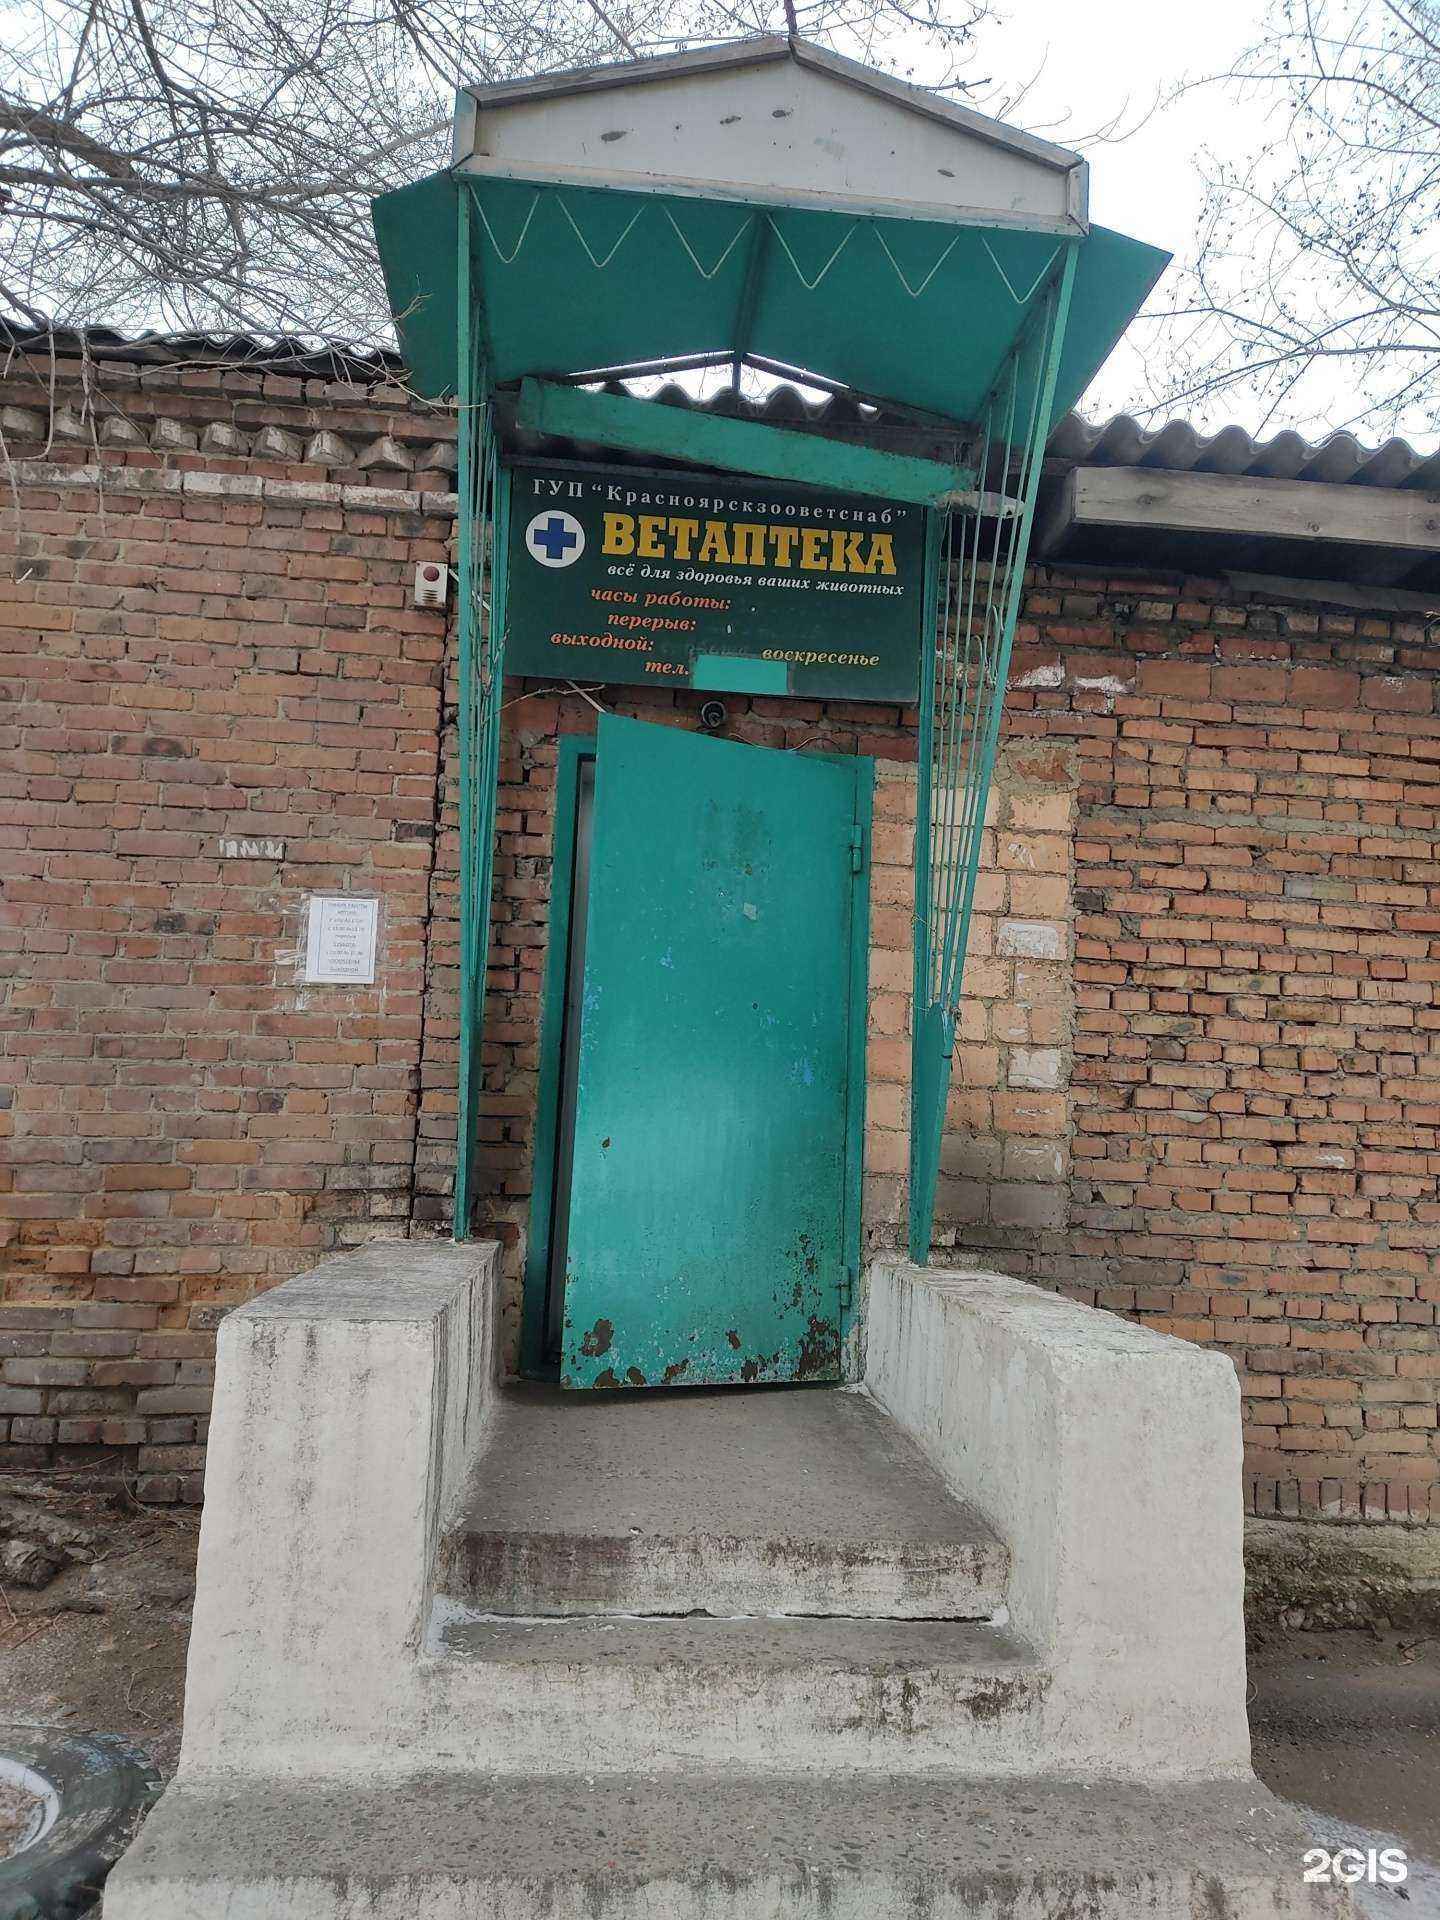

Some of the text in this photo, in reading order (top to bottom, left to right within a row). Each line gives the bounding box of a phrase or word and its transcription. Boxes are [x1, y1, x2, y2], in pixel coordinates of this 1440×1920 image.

[532, 479, 583, 498] ГУП
[601, 513, 897, 575] ВЕТАПТЕКА
[608, 563, 905, 596] всё для здоровья ваших животных
[591, 588, 730, 610] часы работы:
[608, 614, 696, 633] перерыв:
[550, 633, 654, 651] выходной:
[761, 648, 880, 666] воскресенье
[645, 660, 689, 676] тел.
